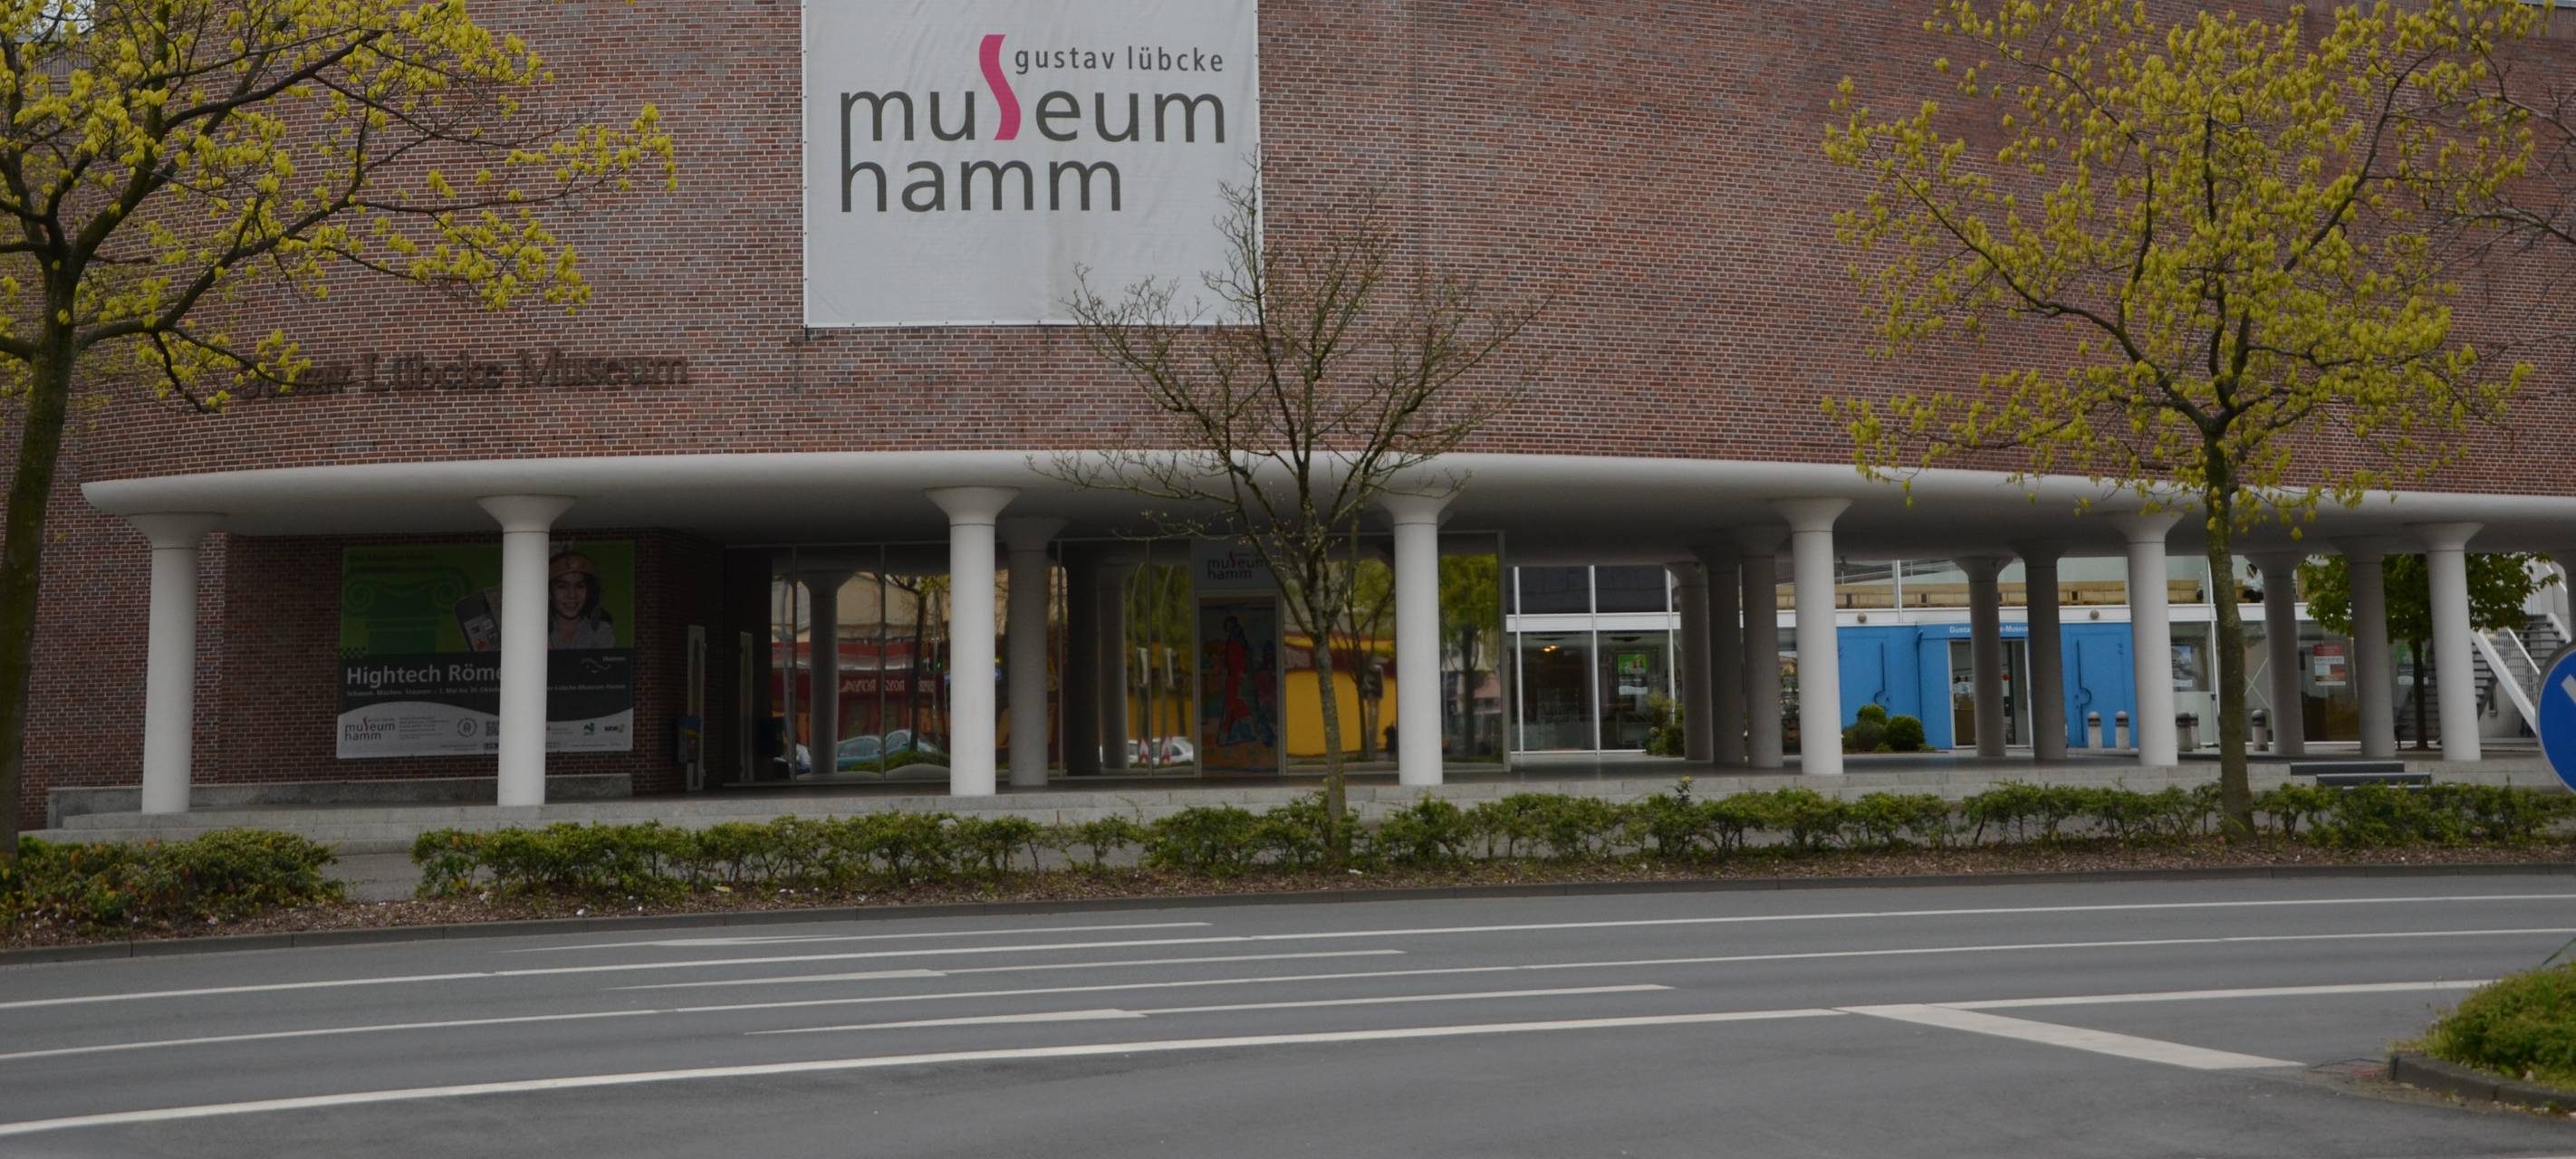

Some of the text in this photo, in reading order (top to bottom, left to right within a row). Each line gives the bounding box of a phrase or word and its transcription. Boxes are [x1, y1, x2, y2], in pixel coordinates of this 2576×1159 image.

[1014, 45, 1224, 75] gustav lübcke
[840, 34, 1226, 143] museum
[840, 142, 1121, 213] hamm
[363, 350, 504, 392] Lübcke
[514, 347, 689, 388] Museum
[1206, 568, 1252, 580] hamm
[1948, 626, 1971, 634] Gusta
[346, 663, 441, 689] Hightech
[344, 716, 396, 733] museum
[344, 731, 382, 741] hamm
